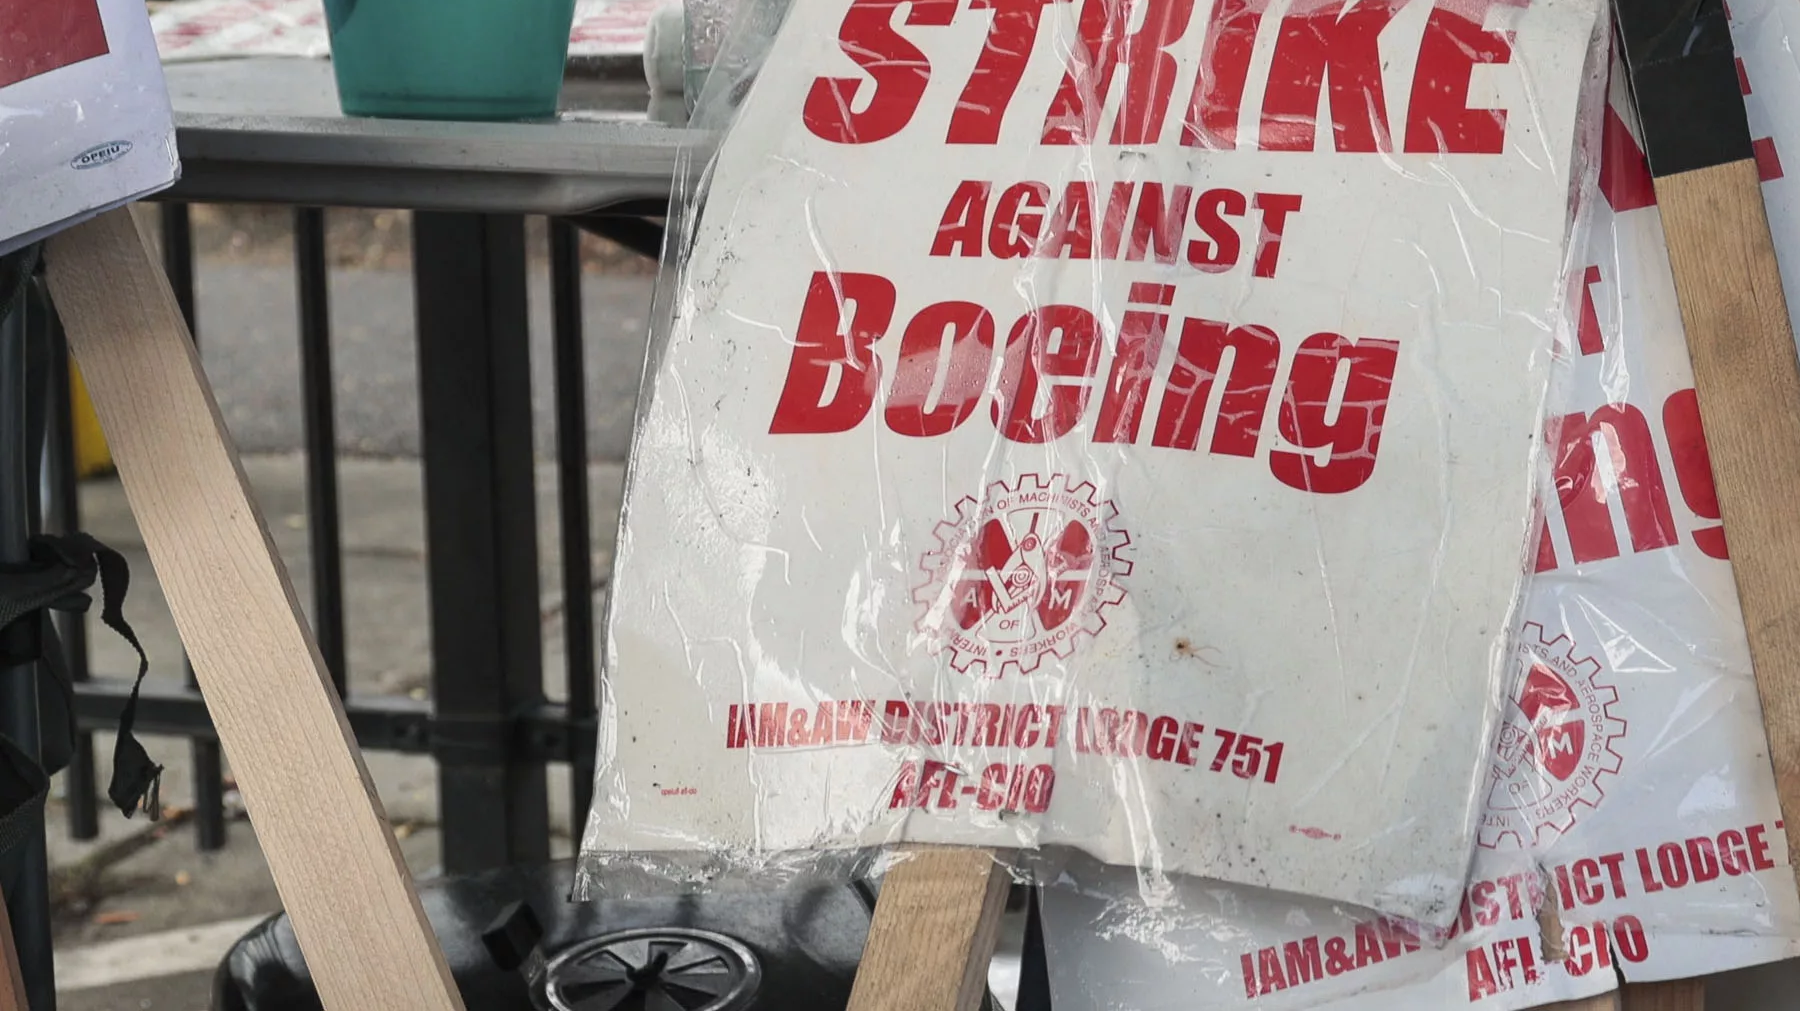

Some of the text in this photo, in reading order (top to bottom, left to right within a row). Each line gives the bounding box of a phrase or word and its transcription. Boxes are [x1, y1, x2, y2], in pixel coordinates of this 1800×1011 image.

[930, 180, 1302, 278] AGAINST
[769, 271, 1401, 495] Boeing
[726, 699, 1286, 785] IAM&AW DISTRICT LODGE 751
[888, 760, 1056, 813] AFL-CIO
[1635, 824, 1774, 895] LODGE
